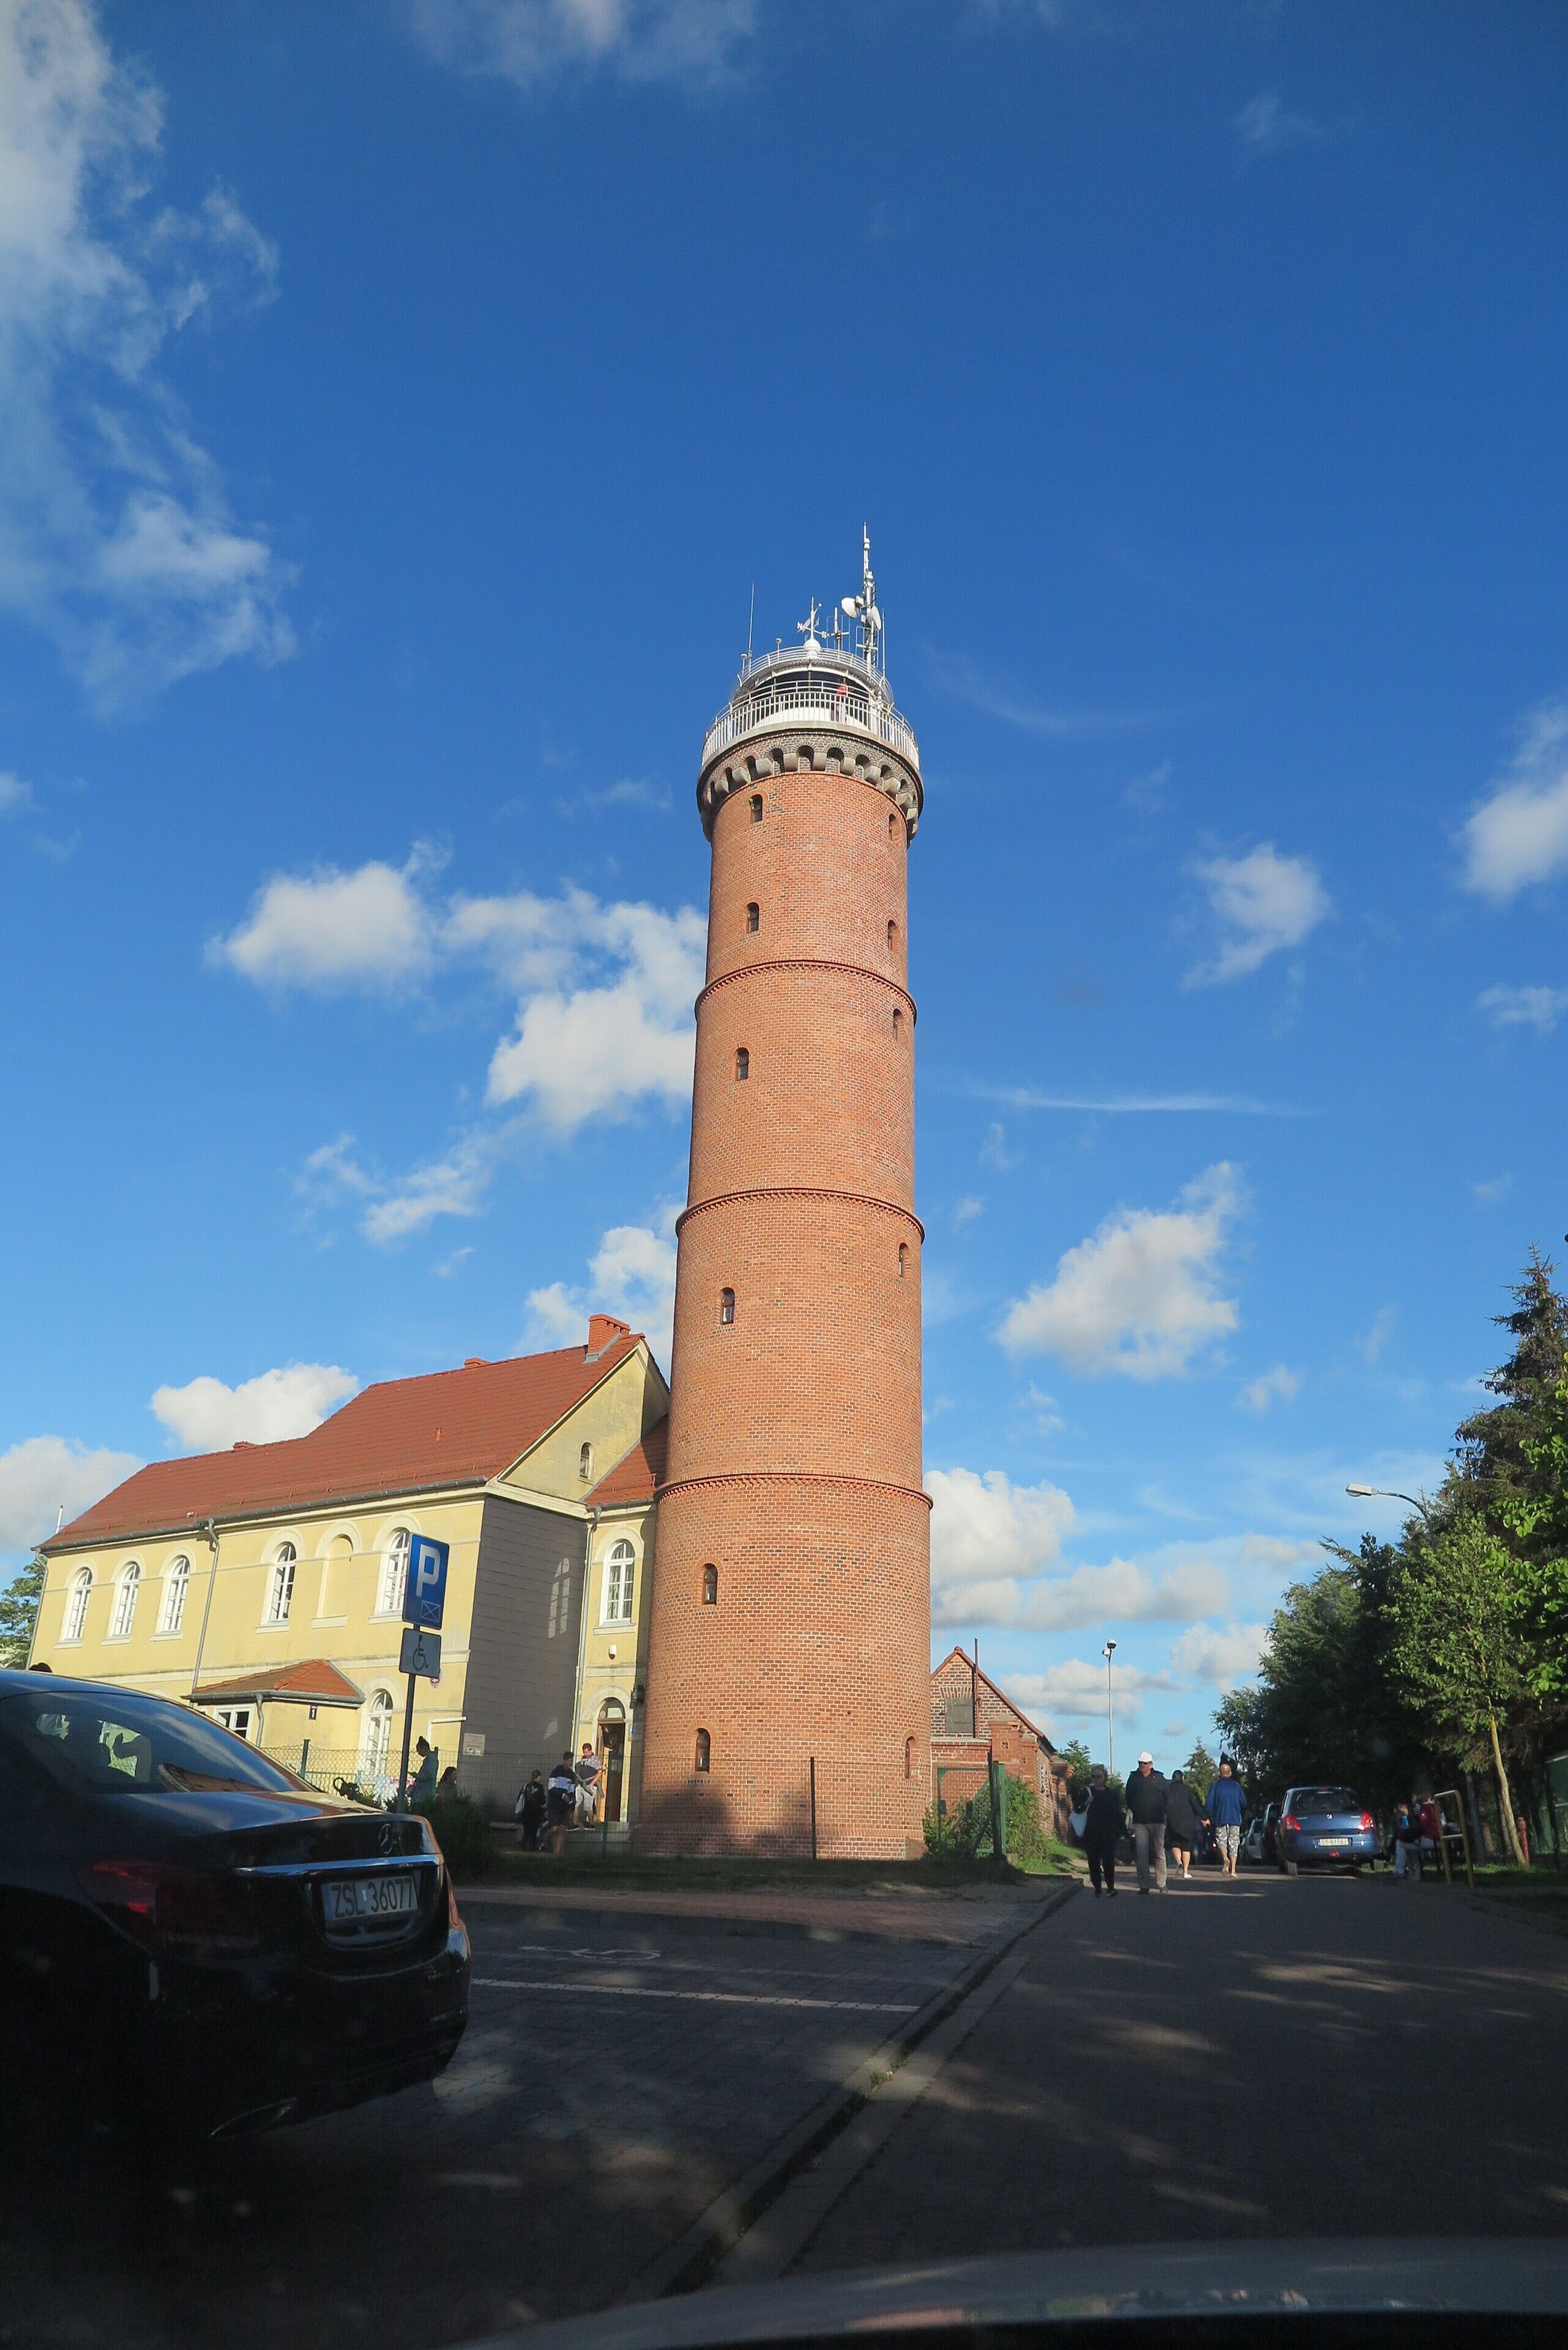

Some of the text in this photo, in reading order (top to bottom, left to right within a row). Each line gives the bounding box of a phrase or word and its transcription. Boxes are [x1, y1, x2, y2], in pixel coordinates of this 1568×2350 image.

[416, 1543, 441, 1597] P
[331, 1878, 413, 1918] ZSL 36077
